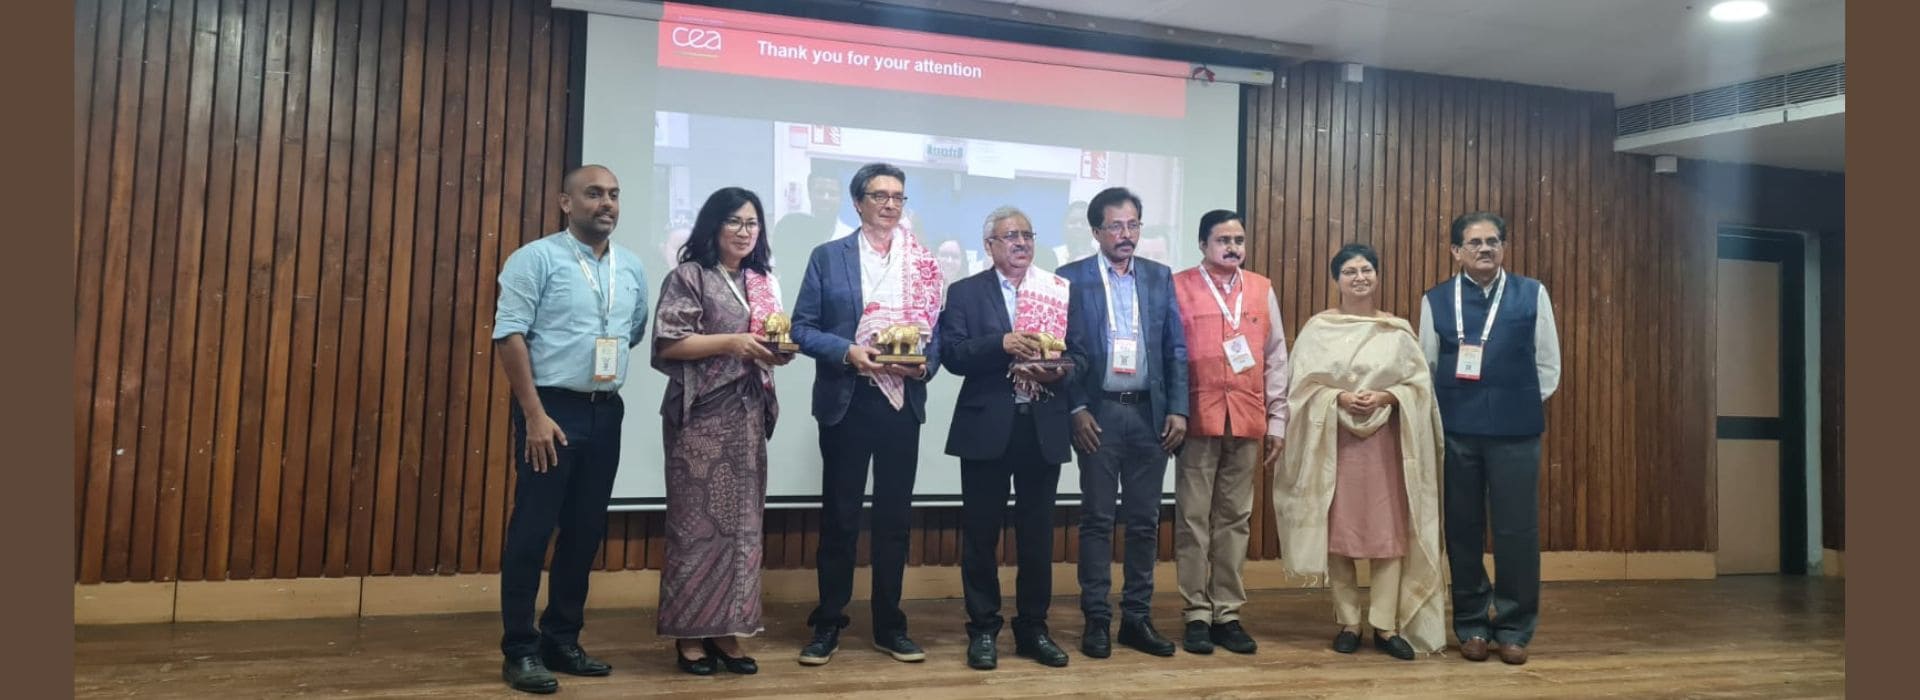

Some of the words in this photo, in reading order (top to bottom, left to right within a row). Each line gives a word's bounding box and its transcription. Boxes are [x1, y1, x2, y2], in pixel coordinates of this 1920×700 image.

[672, 27, 722, 51] cea
[757, 40, 807, 60] Thank
[812, 48, 842, 64] you
[847, 50, 870, 67] for
[874, 55, 910, 71] your
[914, 59, 982, 79] attention
